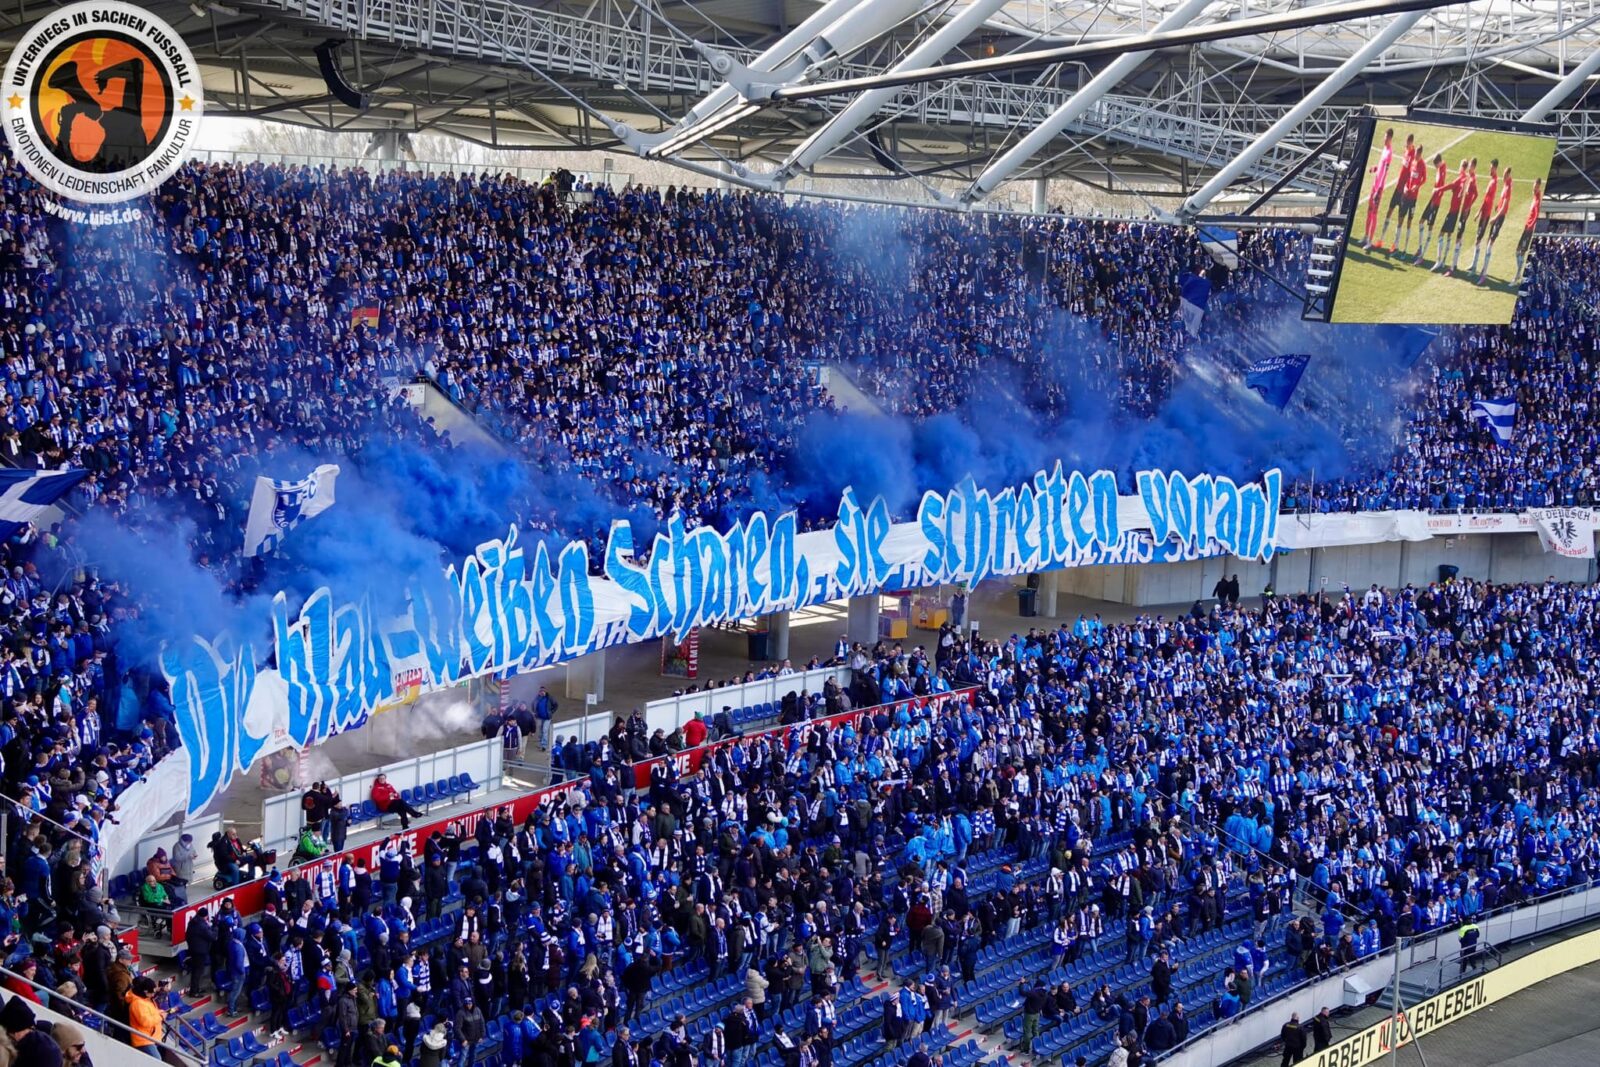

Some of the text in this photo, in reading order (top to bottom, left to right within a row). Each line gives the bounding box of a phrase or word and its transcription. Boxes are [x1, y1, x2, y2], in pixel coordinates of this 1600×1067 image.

[159, 632, 275, 822] Die
[604, 509, 811, 646] Scharen,
[916, 458, 1121, 593] schreiten
[1135, 467, 1282, 565] voran!
[1316, 1030, 1376, 1067] ARBEIT
[1414, 978, 1488, 1035] ERLEBEN.
